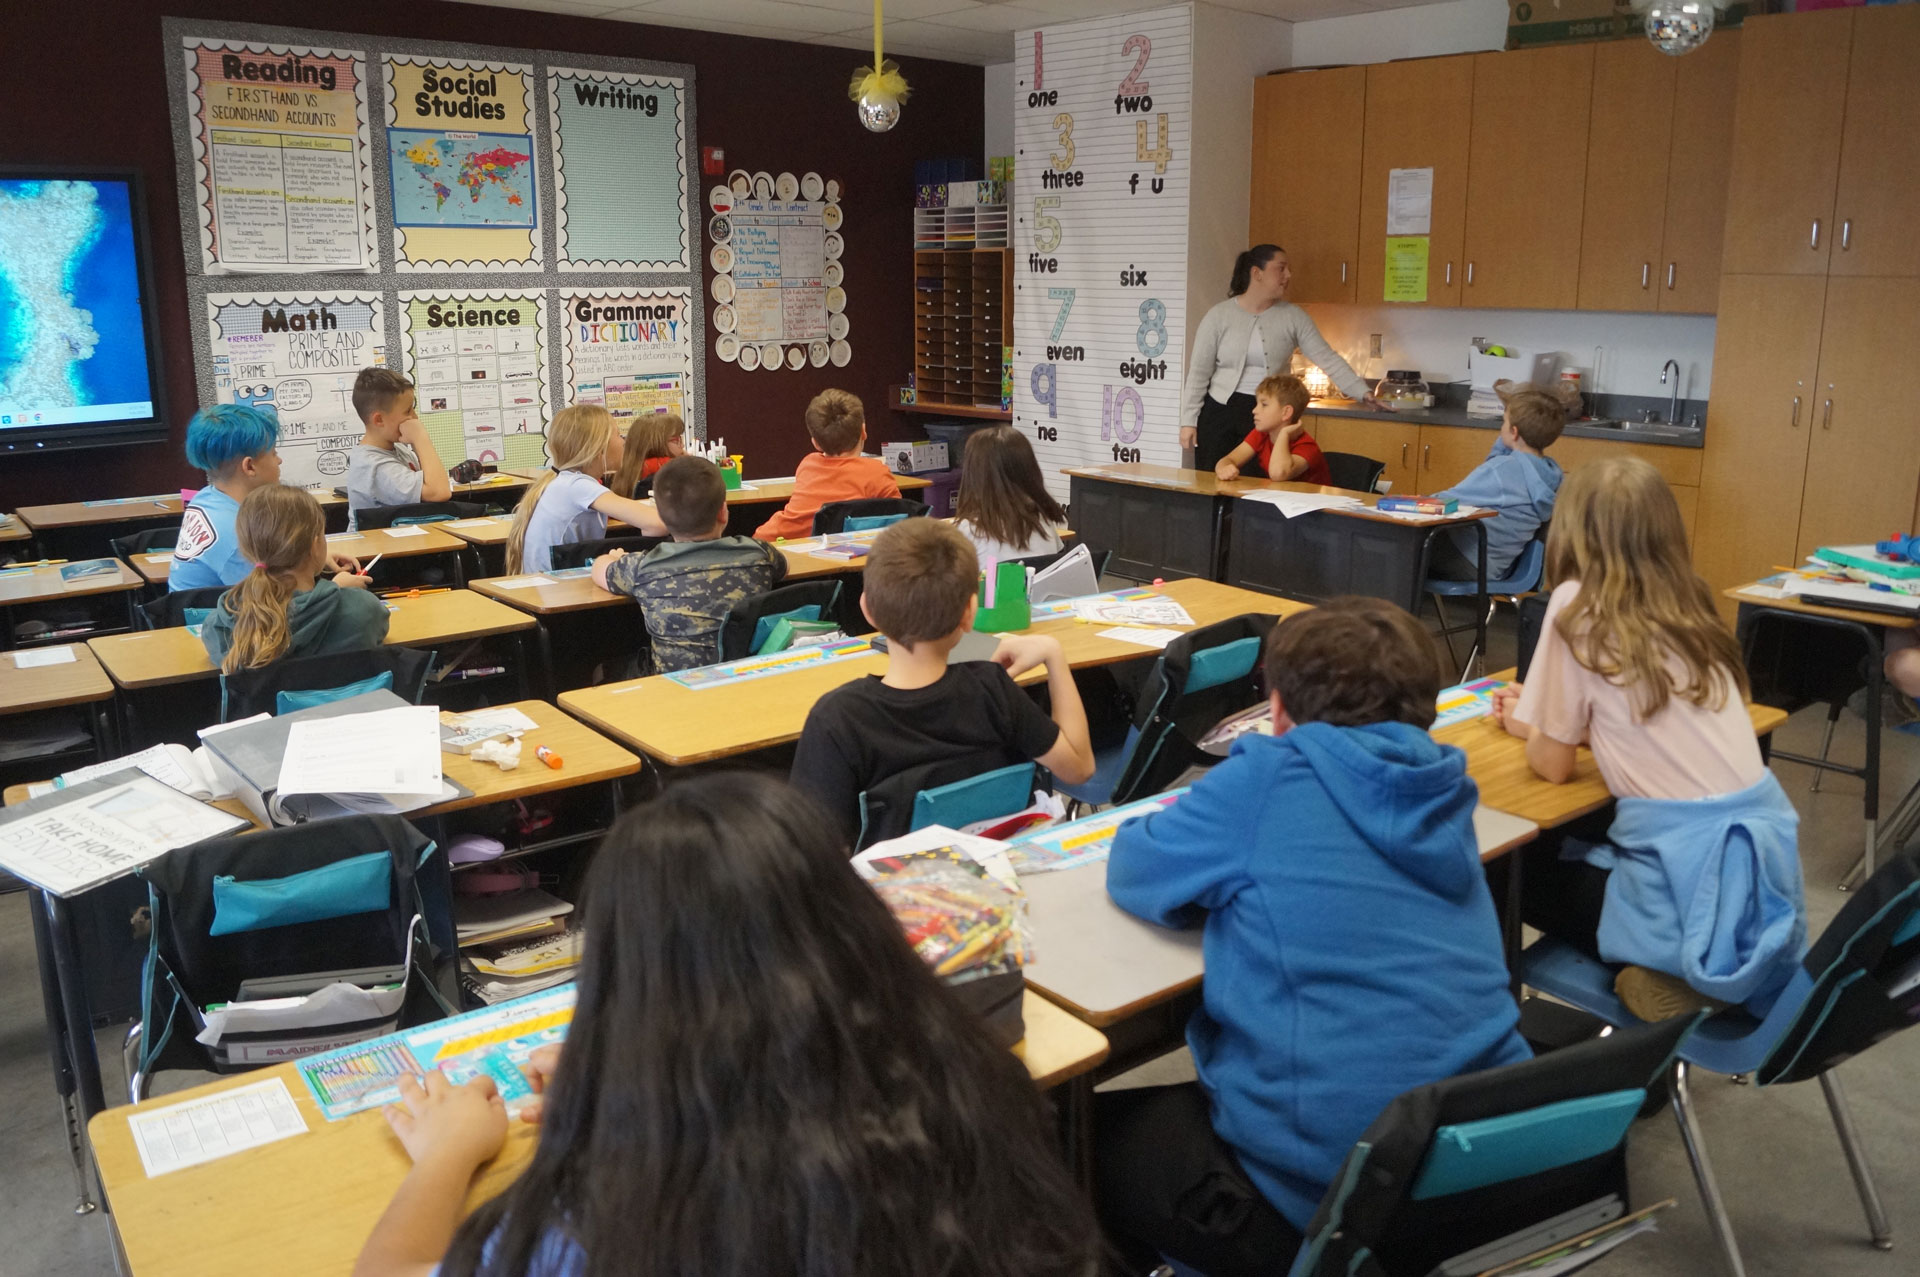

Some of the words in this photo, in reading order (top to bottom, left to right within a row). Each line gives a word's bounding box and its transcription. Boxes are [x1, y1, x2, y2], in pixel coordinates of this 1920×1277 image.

[222, 54, 336, 91] Reading
[1118, 34, 1151, 96] 2
[423, 68, 497, 97] Social
[227, 87, 300, 106] FIRSTHAND
[304, 94, 318, 107] VS
[415, 92, 506, 120] Studies
[573, 83, 659, 117] Writing
[1028, 90, 1058, 107] one
[1114, 94, 1153, 114] two
[211, 105, 280, 123] SECONDHAND
[285, 110, 336, 127] ACCOUNTS
[1050, 113, 1075, 171] 3
[1136, 113, 1173, 174] 4
[1042, 170, 1084, 189] three
[1034, 196, 1062, 253] 5
[1029, 253, 1058, 273] five
[1119, 264, 1148, 287] six
[262, 307, 337, 333] Math
[427, 304, 520, 328] Science
[575, 300, 676, 322] Grammar
[1048, 288, 1076, 343] 7
[1136, 298, 1168, 358] 8
[288, 332, 329, 350] PRIME
[335, 331, 364, 349] AND
[581, 320, 678, 343] DICTIONARY
[288, 348, 361, 370] COMPOSITE
[1047, 345, 1084, 361] even
[240, 364, 266, 378] PRIME
[1120, 357, 1167, 385] eight
[1031, 363, 1057, 418] 9
[322, 422, 335, 432] AND
[337, 421, 349, 431] ME
[1101, 385, 1144, 444] 10
[1112, 443, 1141, 463] ten
[1, 827, 103, 878] BINDER
[34, 817, 83, 842] TAKE
[72, 838, 134, 865] HOME
